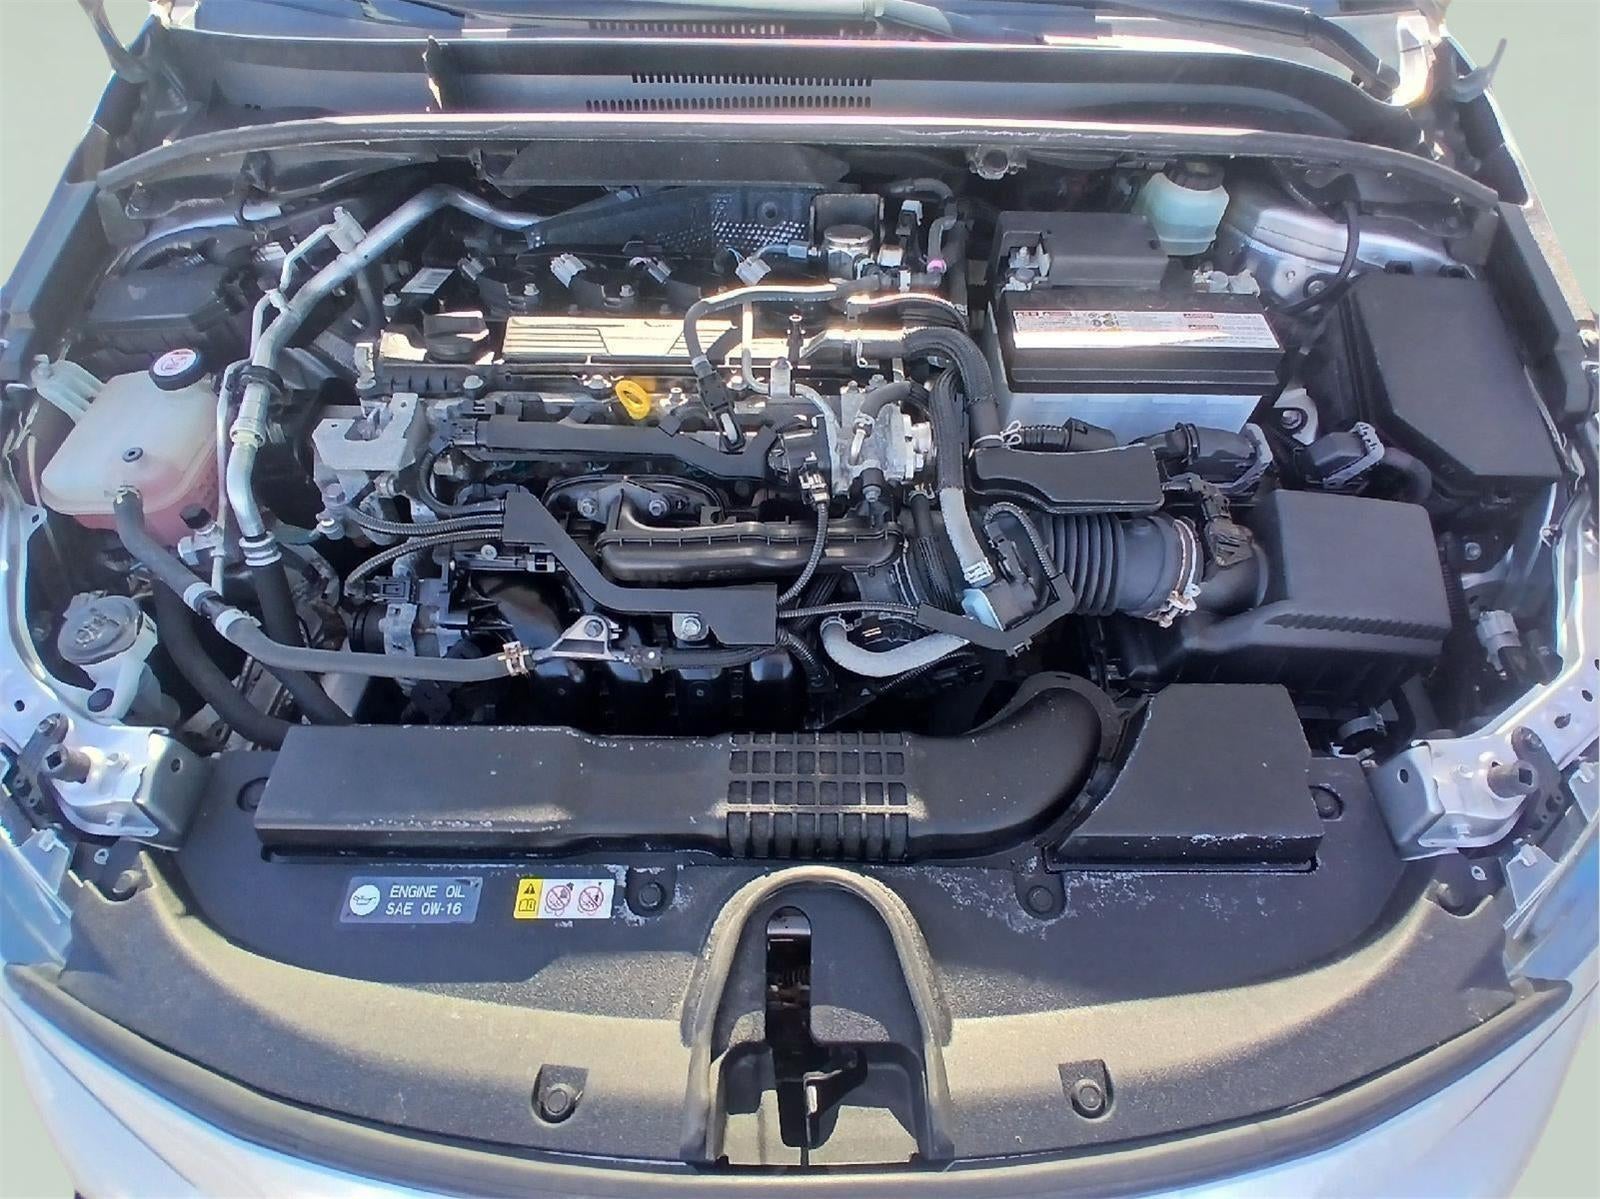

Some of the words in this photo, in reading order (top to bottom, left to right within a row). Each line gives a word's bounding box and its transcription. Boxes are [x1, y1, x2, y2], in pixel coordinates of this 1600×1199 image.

[389, 884, 439, 898] ENGINE
[445, 884, 466, 898] OIL
[385, 902, 414, 916] SAE
[421, 902, 463, 916] 0W-16
